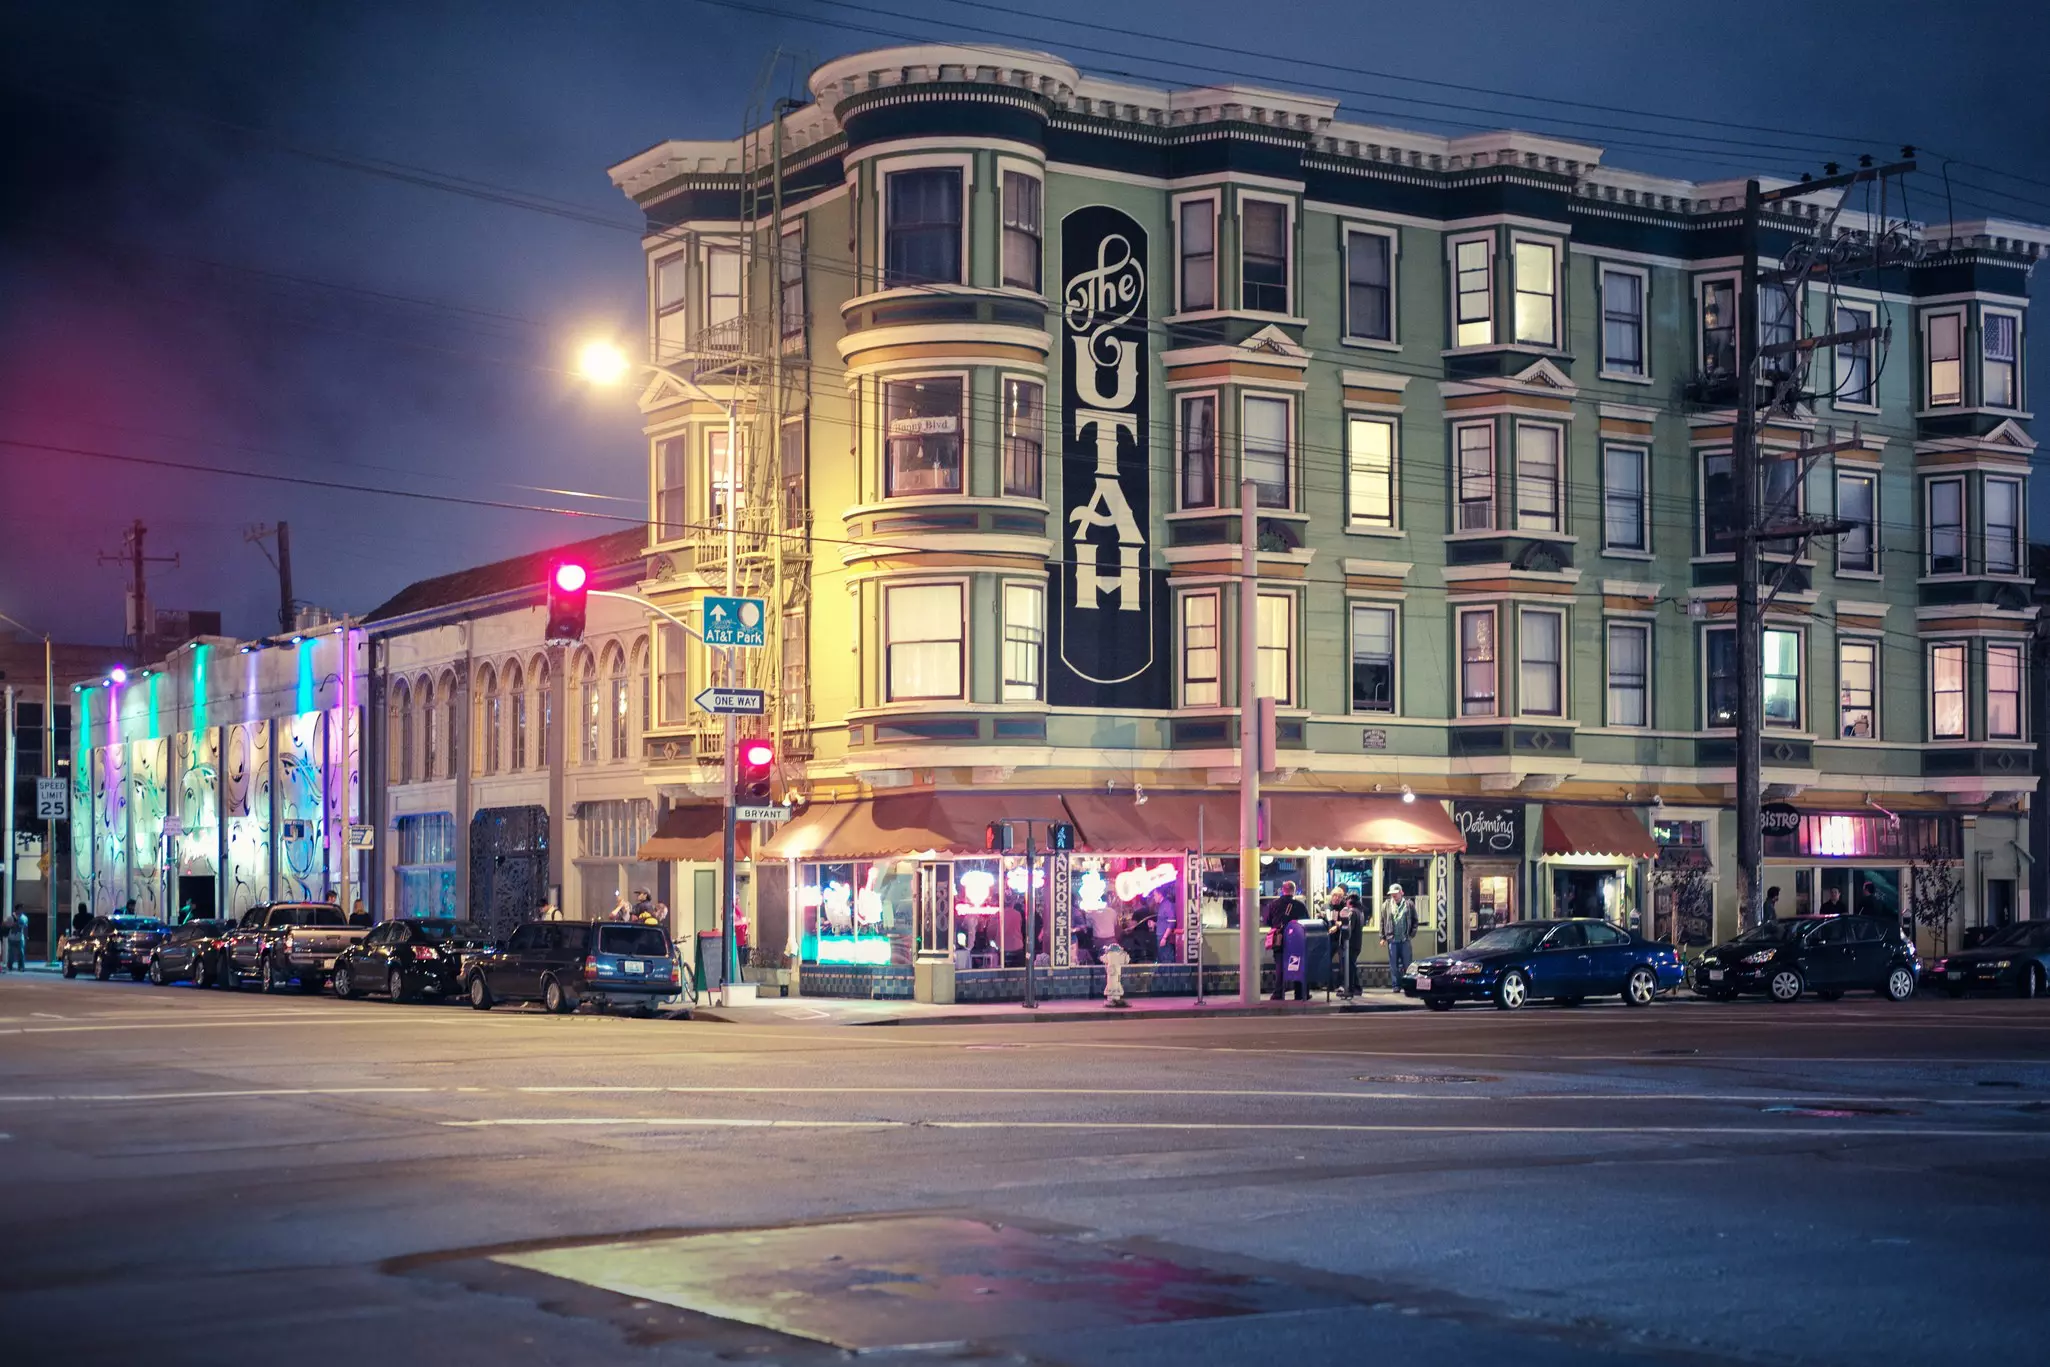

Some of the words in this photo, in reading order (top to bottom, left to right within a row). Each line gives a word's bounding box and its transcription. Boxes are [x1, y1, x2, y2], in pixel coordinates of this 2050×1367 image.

[1065, 234, 1144, 367] The
[1069, 335, 1146, 611] UTAH
[706, 629, 733, 642] AT&T
[736, 631, 763, 644] Park
[715, 696, 734, 706] ONE
[737, 696, 757, 706] WAY
[39, 781, 66, 790] SPEED
[41, 791, 63, 800] LIMIT
[40, 801, 65, 815] 25
[744, 809, 782, 818] BRYANT
[1456, 811, 1514, 850] Performing
[1437, 856, 1447, 943] BASS
